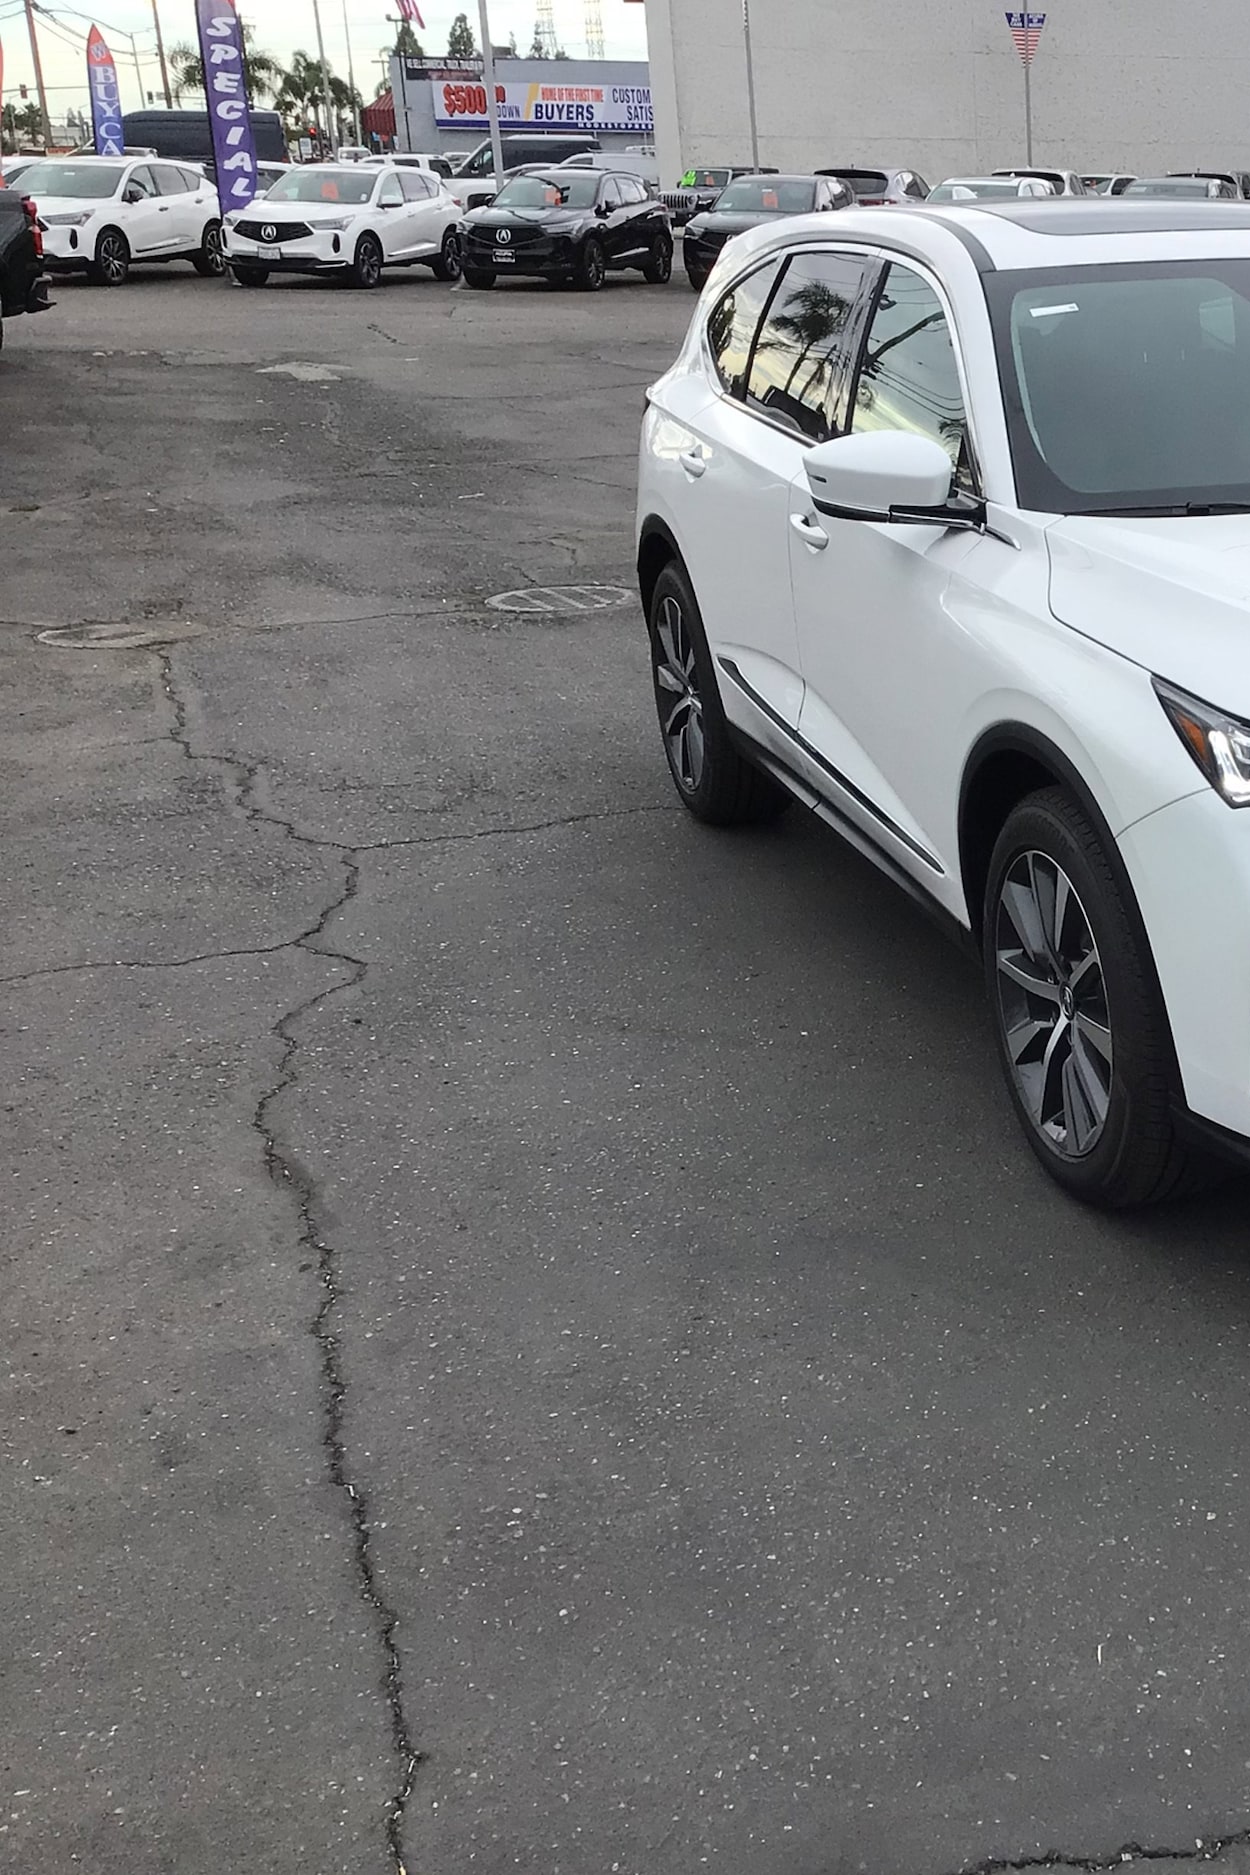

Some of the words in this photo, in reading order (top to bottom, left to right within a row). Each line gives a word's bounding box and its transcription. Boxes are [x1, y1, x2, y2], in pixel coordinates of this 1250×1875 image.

[206, 16, 253, 198] SPECIAL
[443, 83, 488, 118] $500
[612, 88, 651, 104] CUSTOM
[535, 103, 594, 121] BUYERS
